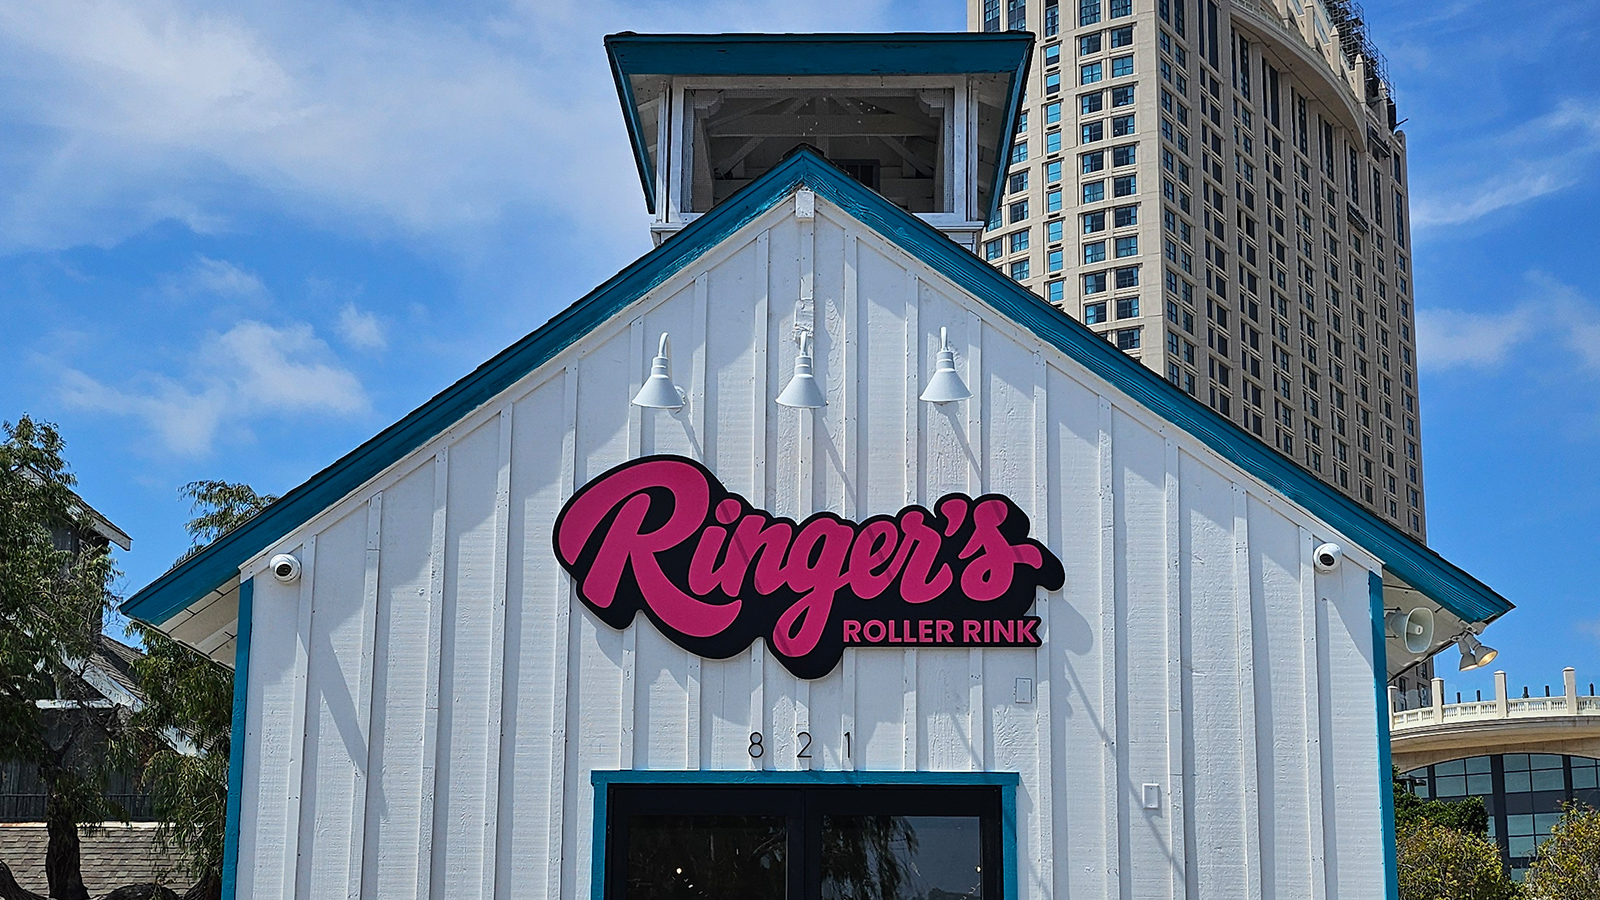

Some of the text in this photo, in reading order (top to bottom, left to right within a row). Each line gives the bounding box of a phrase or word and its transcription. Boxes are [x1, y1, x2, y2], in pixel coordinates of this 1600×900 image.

[558, 460, 1043, 658] Ringer's
[843, 619, 1039, 643] ROLLER RINK
